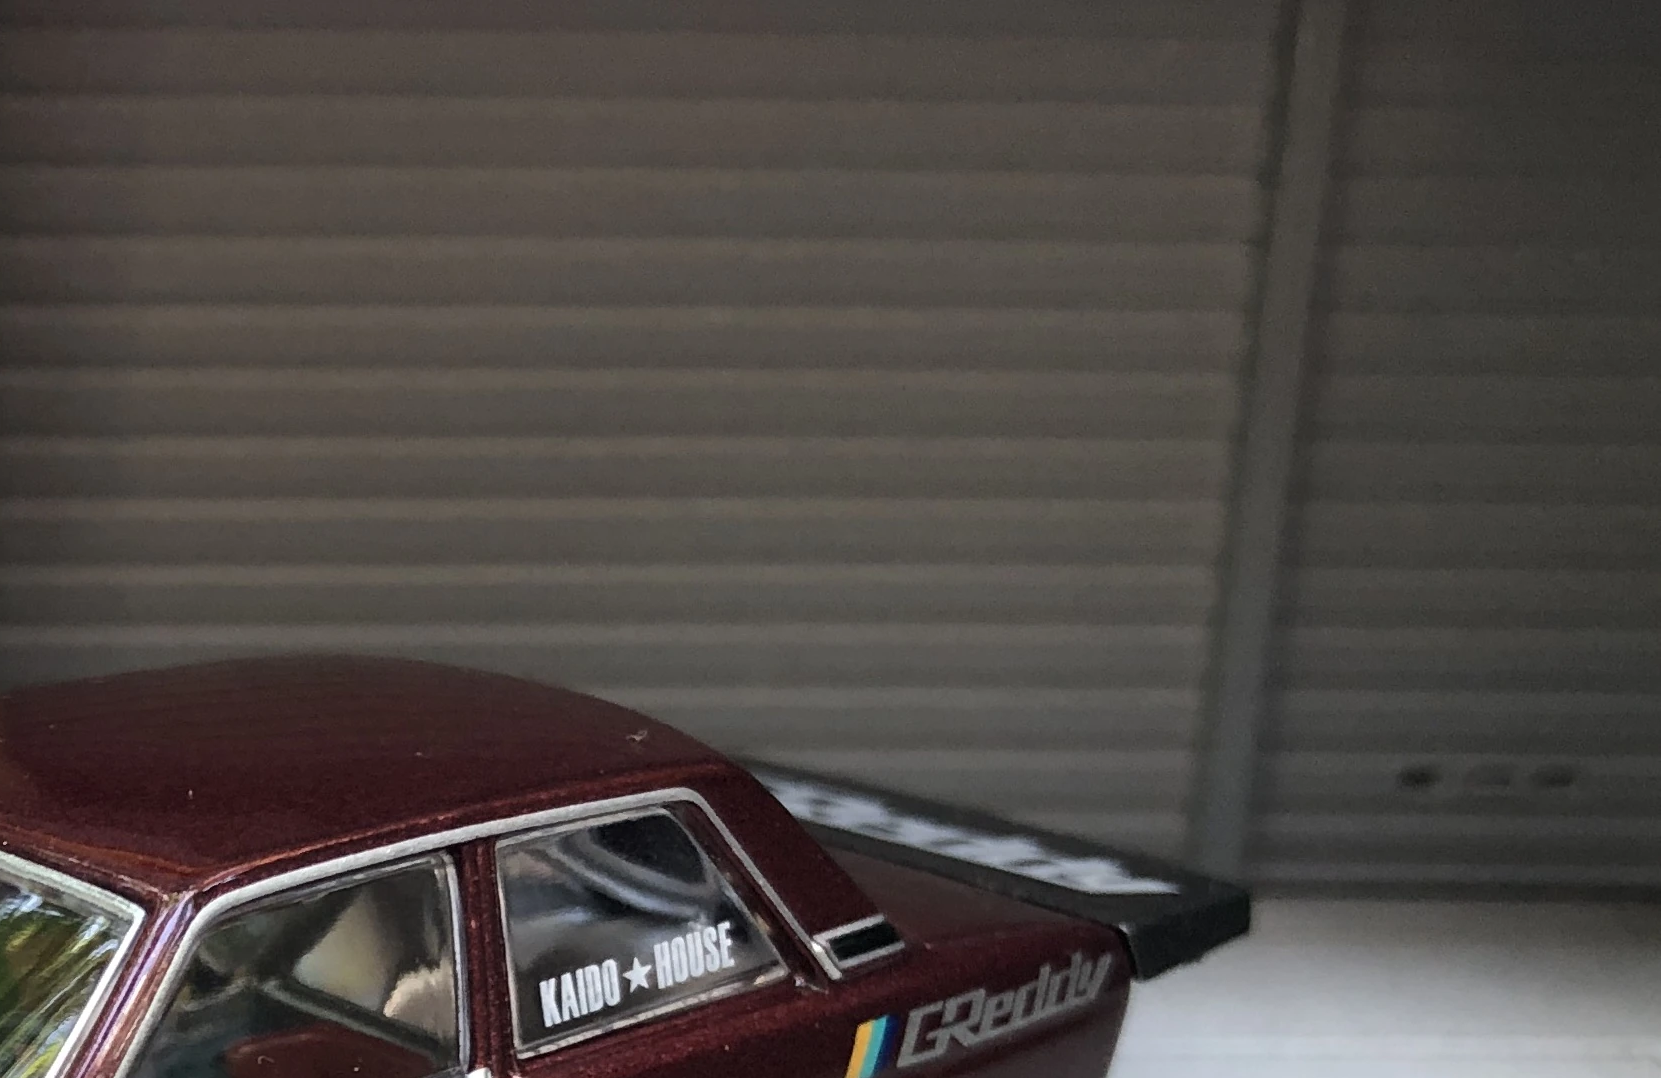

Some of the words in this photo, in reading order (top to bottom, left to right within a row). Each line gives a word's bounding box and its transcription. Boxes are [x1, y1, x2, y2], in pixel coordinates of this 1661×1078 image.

[539, 958, 622, 1028] KAIDO
[653, 920, 736, 990] HOUSE
[896, 950, 1112, 1068] GReddy
